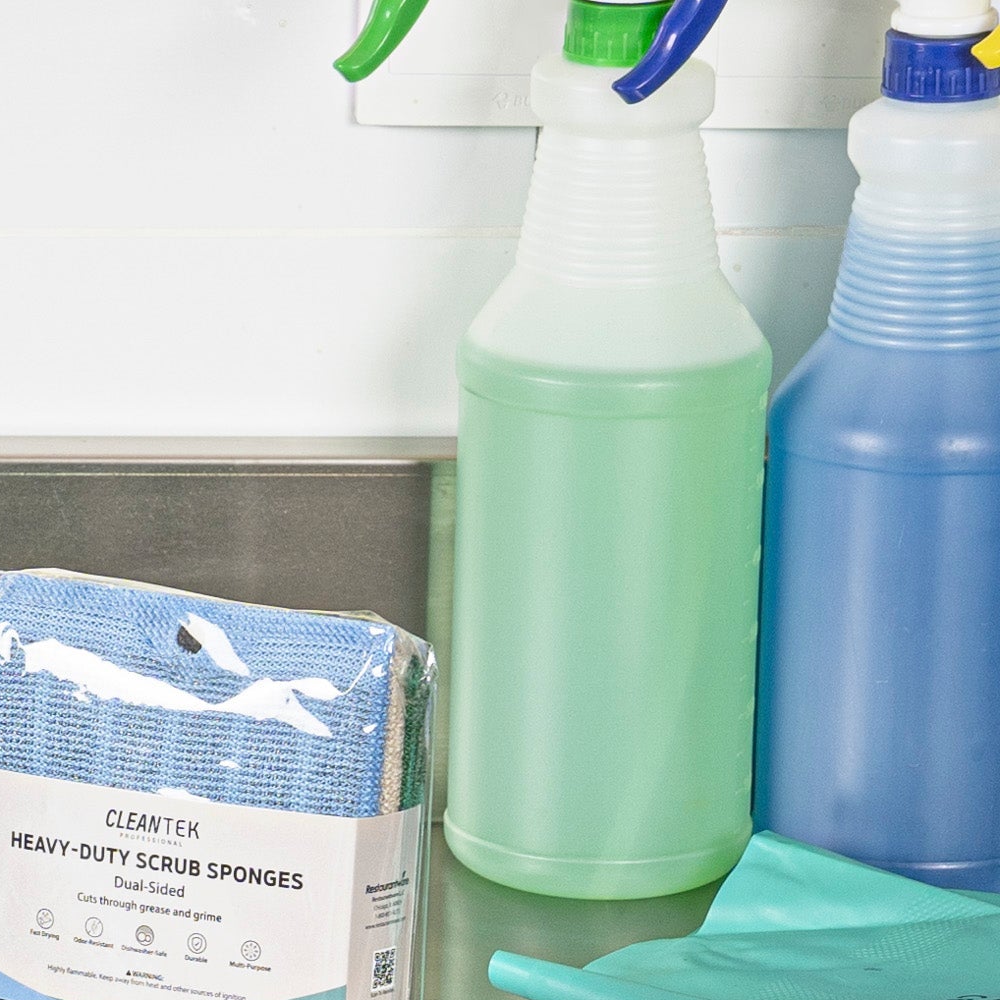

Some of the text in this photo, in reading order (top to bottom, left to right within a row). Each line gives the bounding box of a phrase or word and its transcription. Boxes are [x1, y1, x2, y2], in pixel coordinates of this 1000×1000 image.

[105, 809, 200, 840] CLEANTEK
[119, 832, 183, 848] PROFESSIONAL
[11, 831, 304, 890] HEAVY-DUTY SCRUB SPONGES
[114, 875, 186, 898] Dual-Sided
[76, 892, 222, 923] Cuts through grease and grime
[184, 954, 208, 964] Durable
[228, 960, 272, 973] Multi-Purpose
[172, 984, 190, 994] other
[190, 987, 214, 998] sources
[214, 990, 222, 998] of
